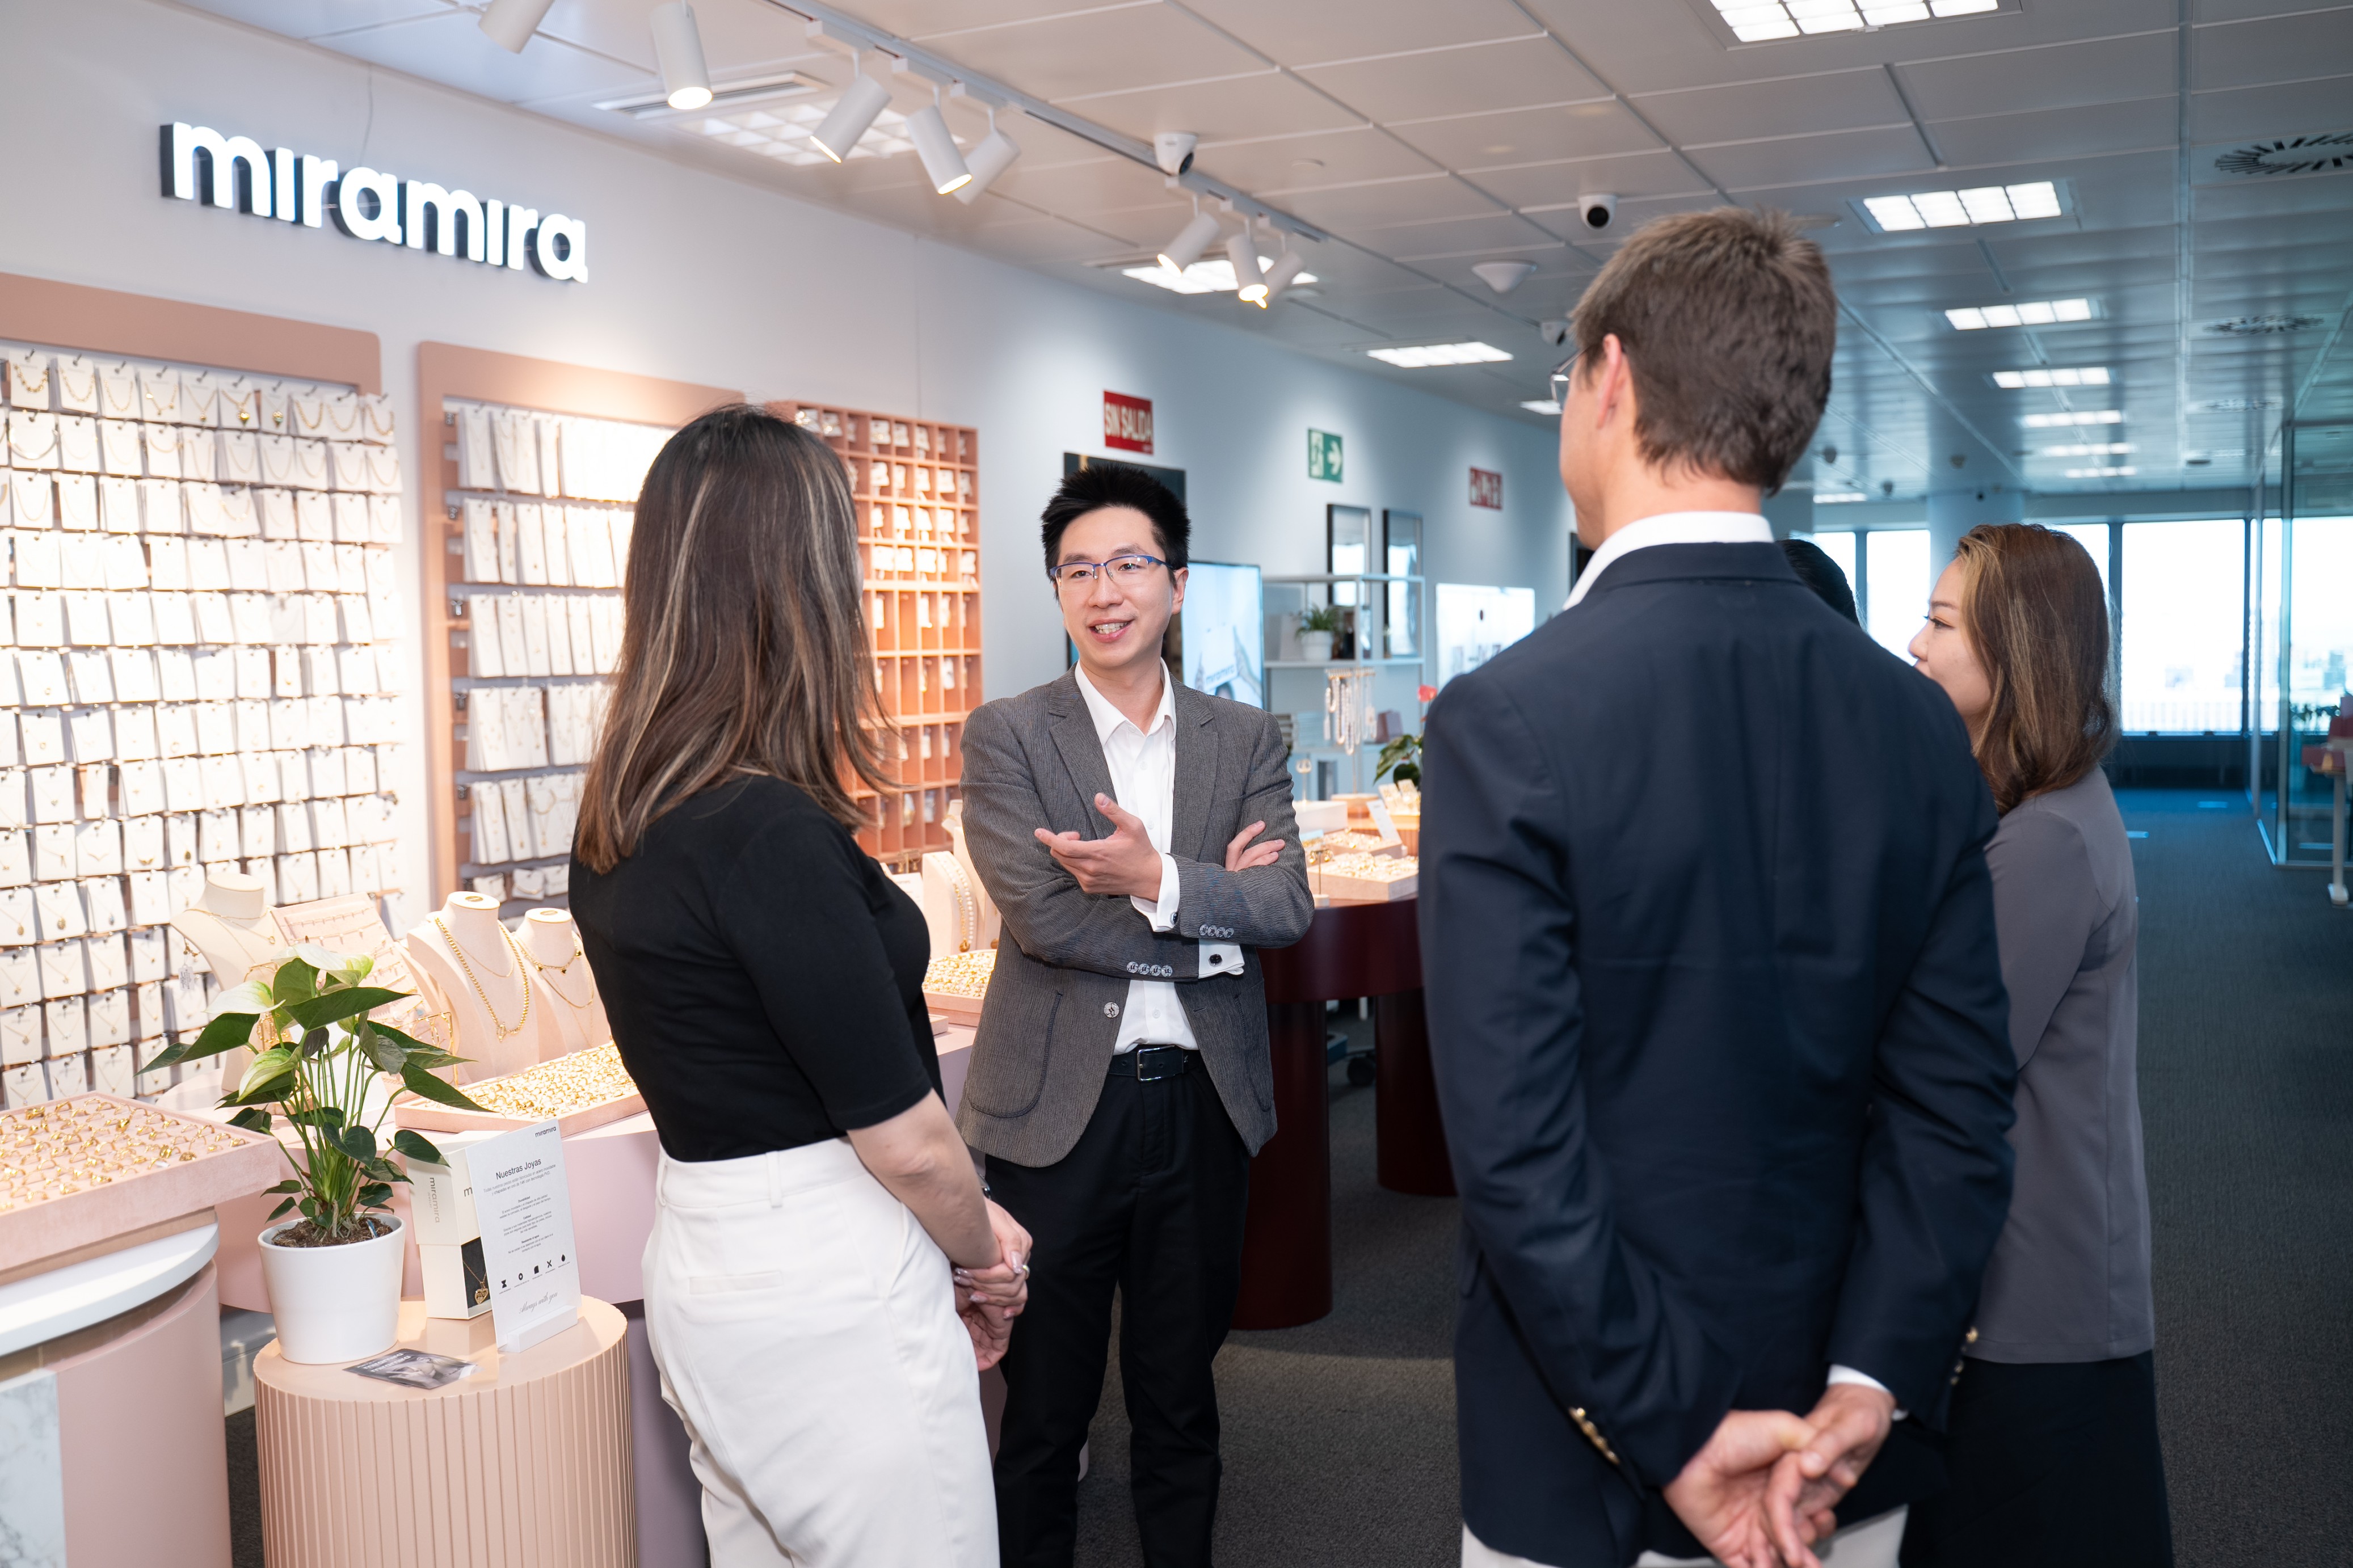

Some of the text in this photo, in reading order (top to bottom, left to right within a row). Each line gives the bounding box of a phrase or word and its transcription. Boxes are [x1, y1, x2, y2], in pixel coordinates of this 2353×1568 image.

[161, 122, 588, 283] miramira
[1105, 402, 1152, 444] SIN SALIDA
[535, 1126, 557, 1137] miramira
[496, 1159, 542, 1180] Nuestras Joyas
[430, 1177, 440, 1223] miramira
[519, 1292, 558, 1314] Always with you
